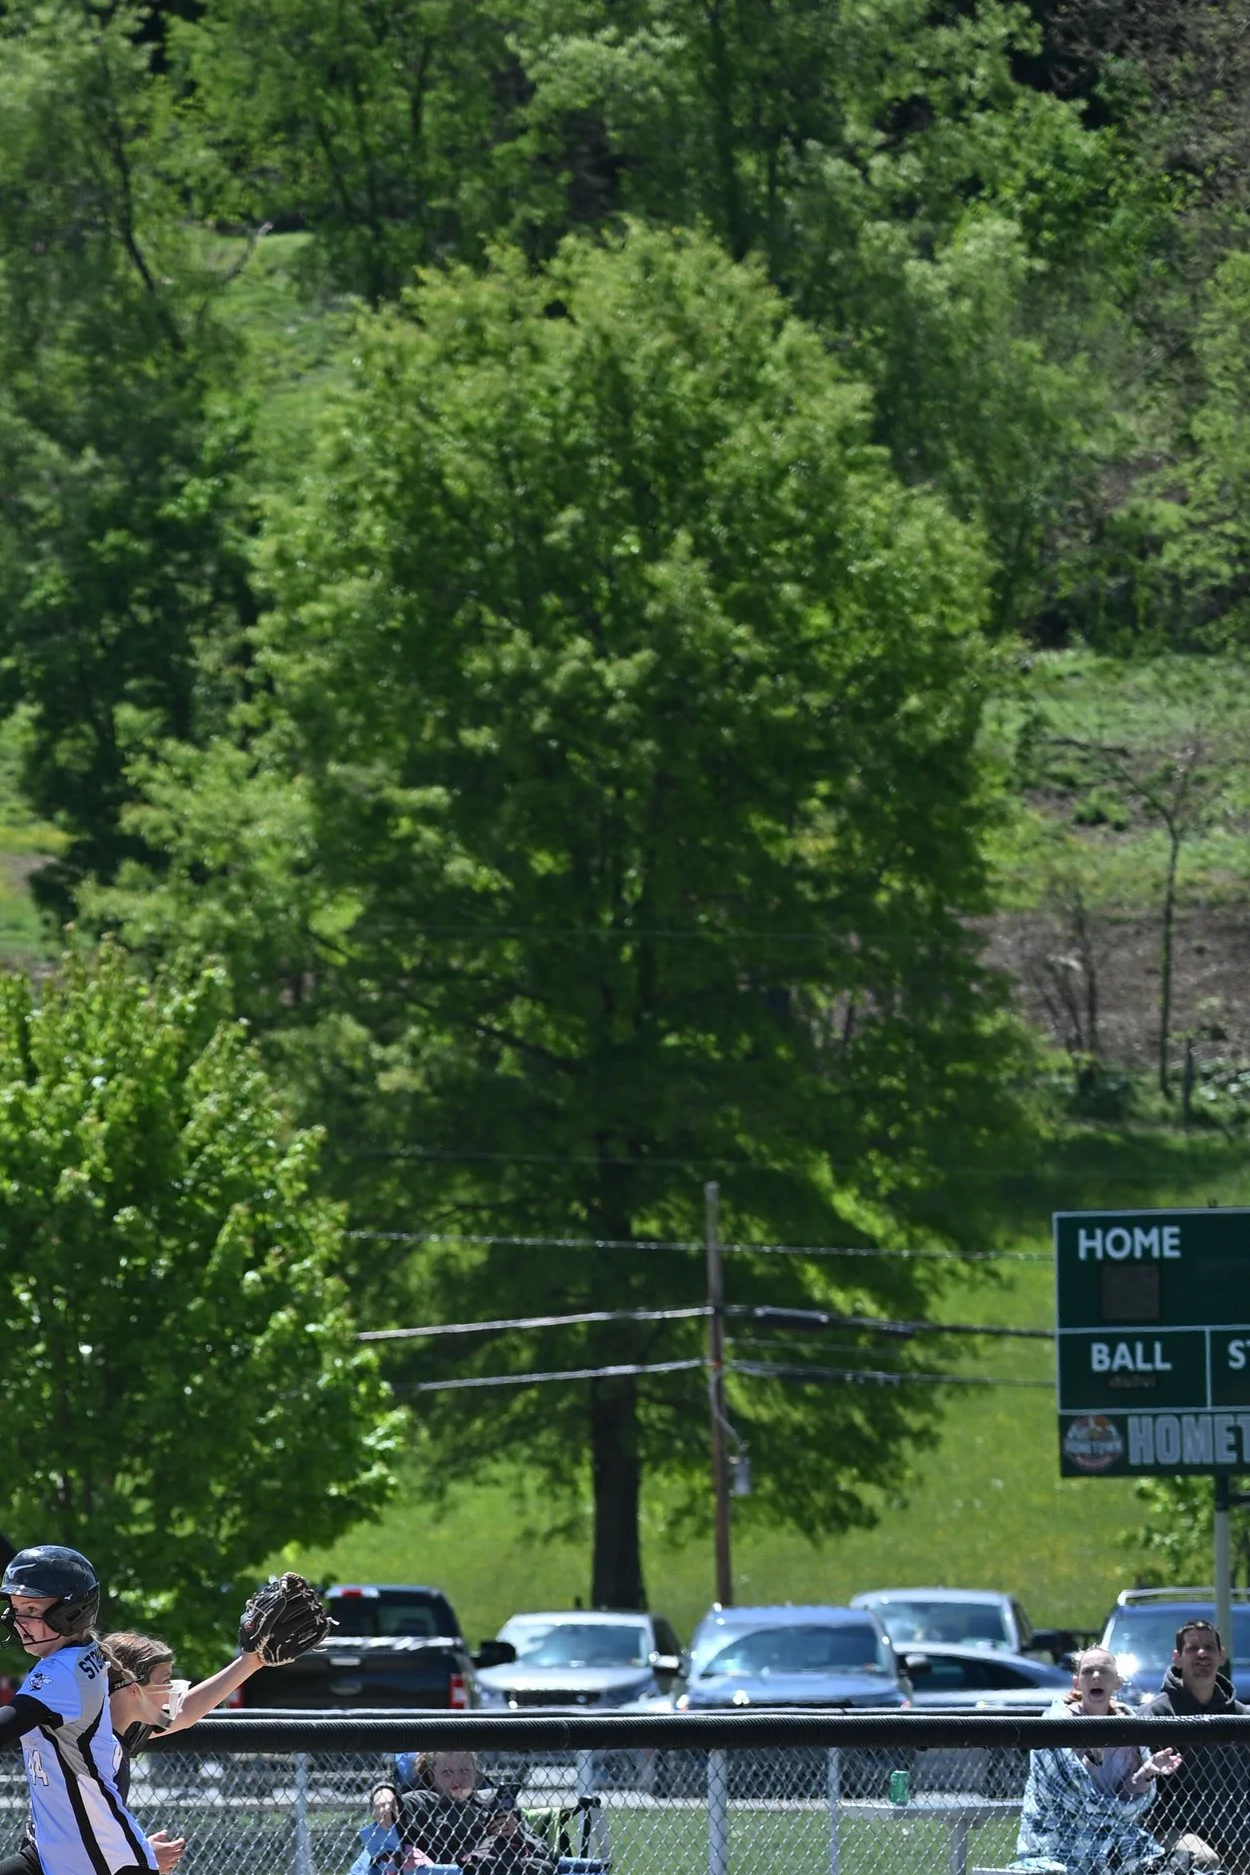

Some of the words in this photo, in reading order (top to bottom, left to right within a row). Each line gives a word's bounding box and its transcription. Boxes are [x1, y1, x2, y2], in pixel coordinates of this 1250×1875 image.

[1077, 1226, 1181, 1260] HOME
[1090, 1341, 1172, 1372] BALL
[1227, 1339, 1250, 1370] S
